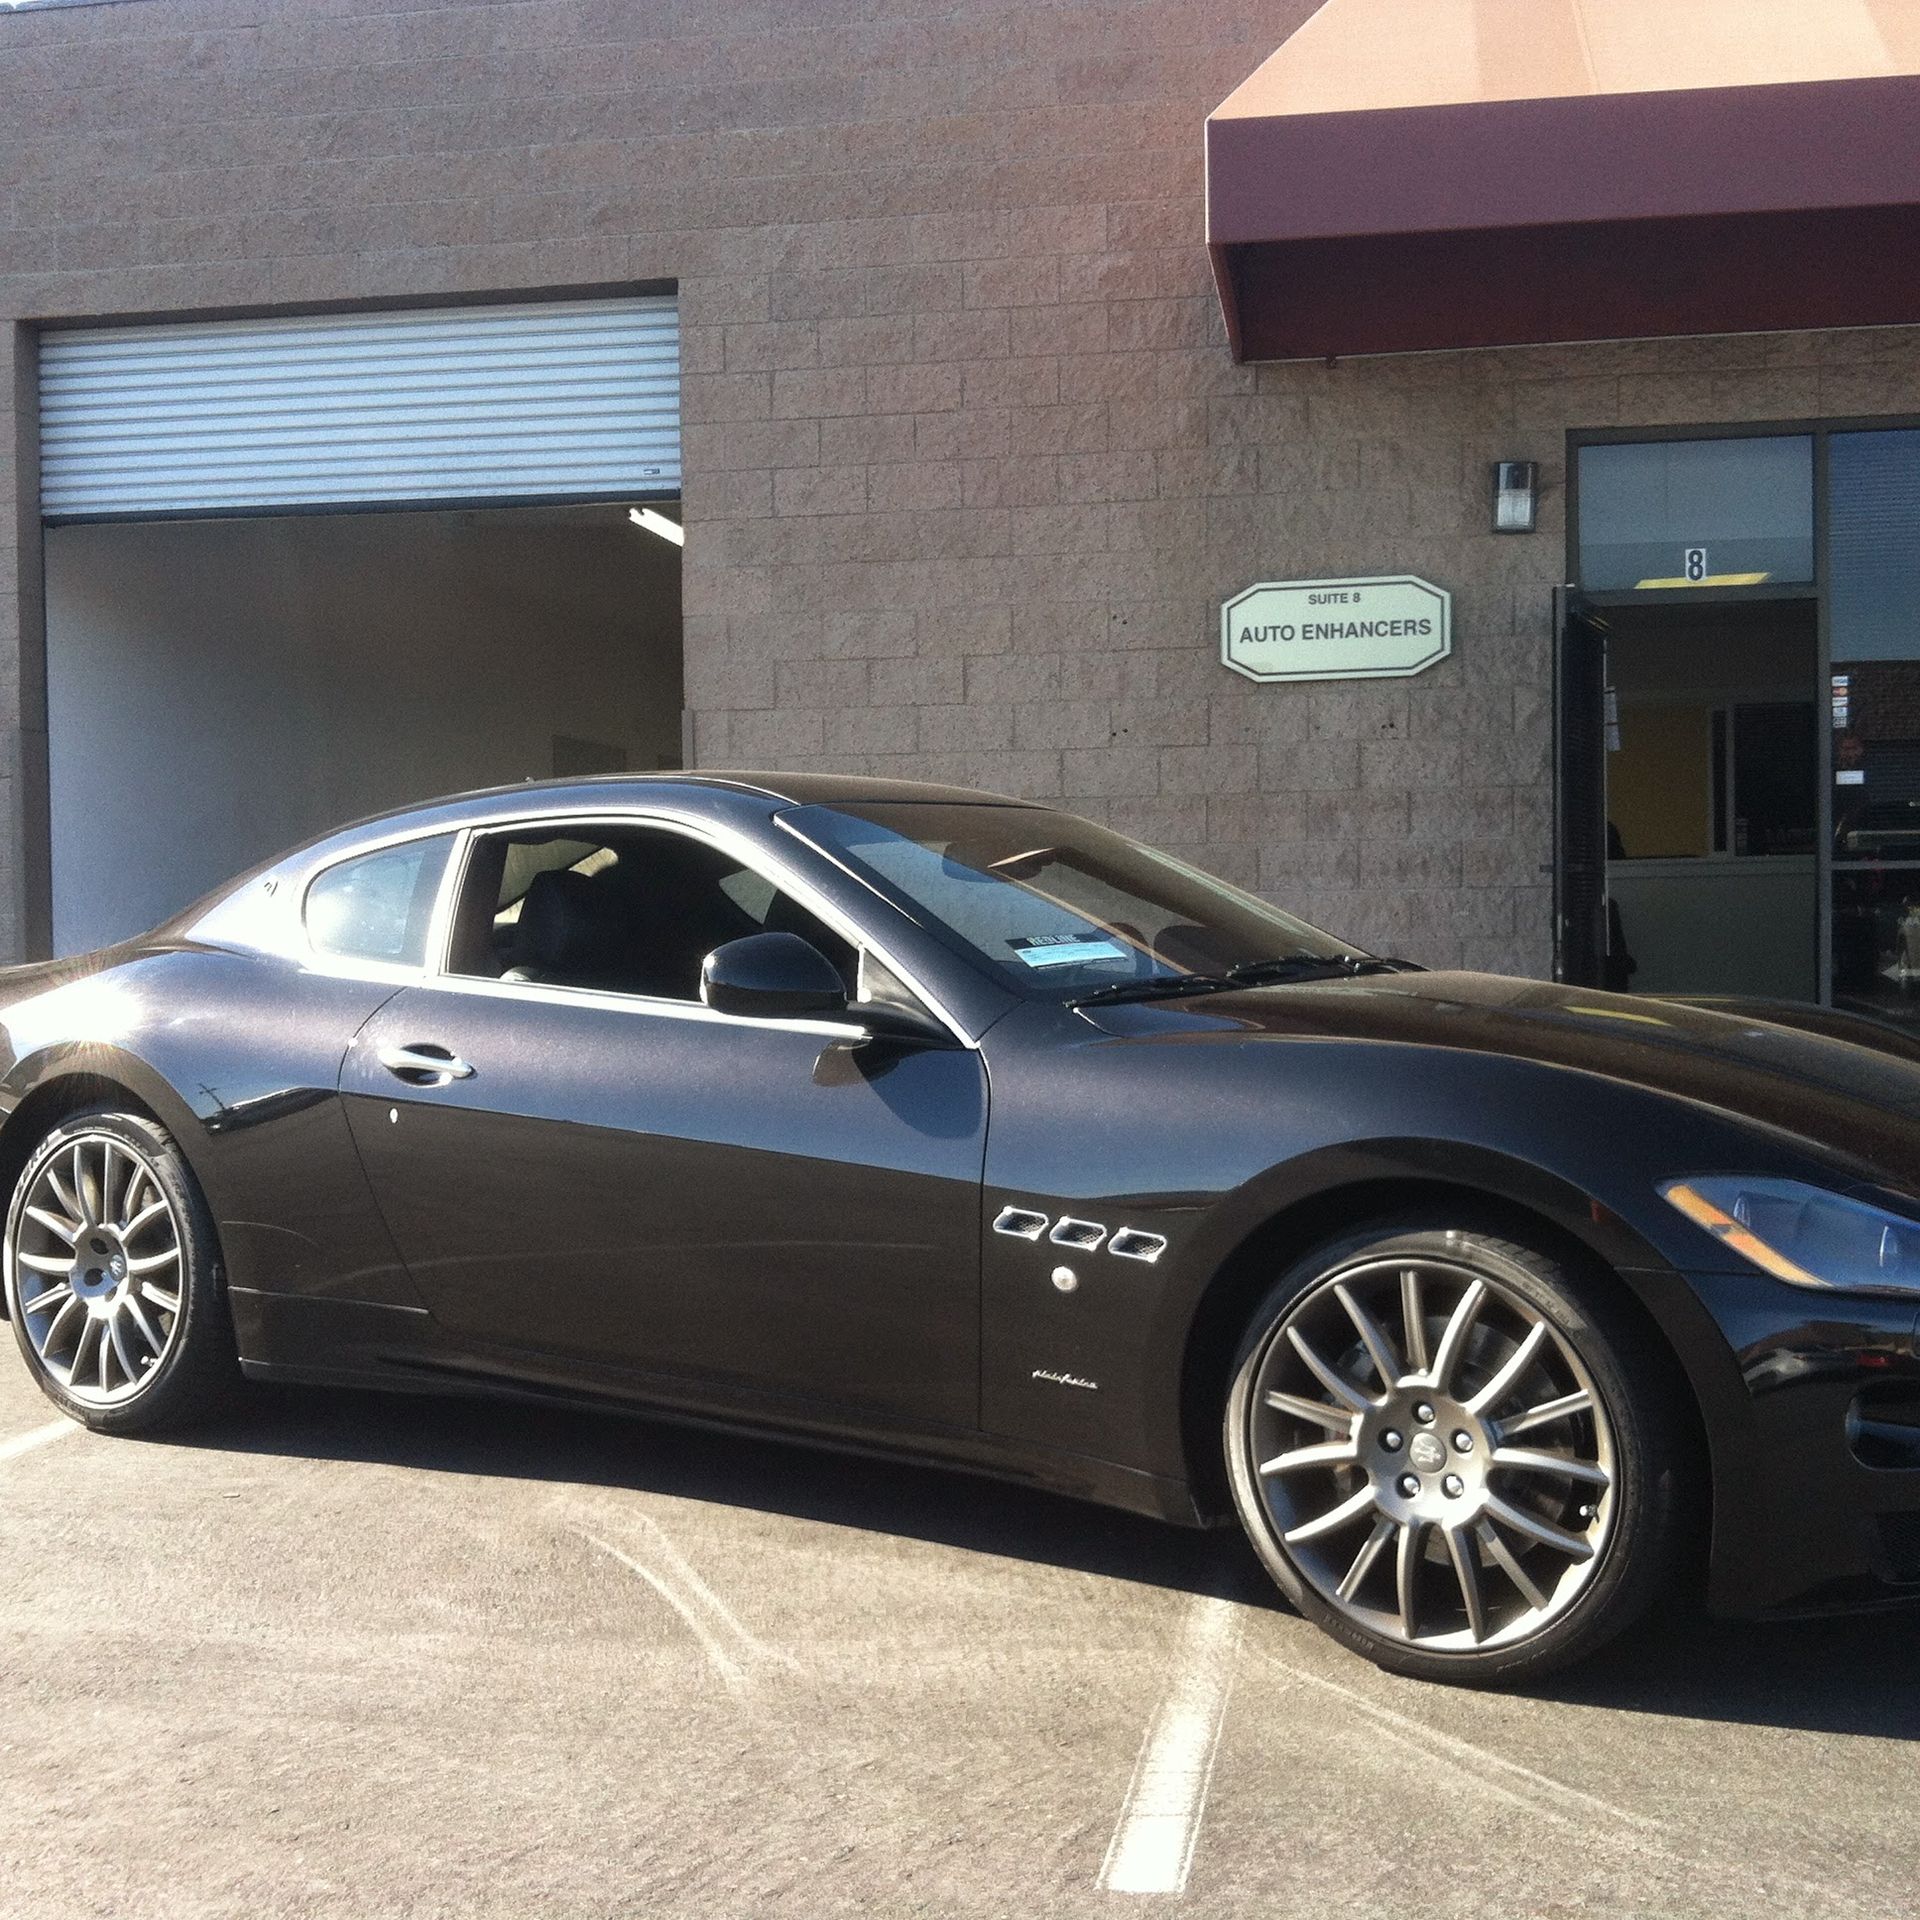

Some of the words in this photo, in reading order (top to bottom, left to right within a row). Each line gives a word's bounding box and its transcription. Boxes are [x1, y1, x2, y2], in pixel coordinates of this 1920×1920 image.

[1687, 549, 1704, 581] 8
[1308, 592, 1349, 605] SUITE
[1352, 592, 1361, 603] 8
[1240, 625, 1295, 643] AUTO
[1302, 618, 1432, 640] ENHANCERS
